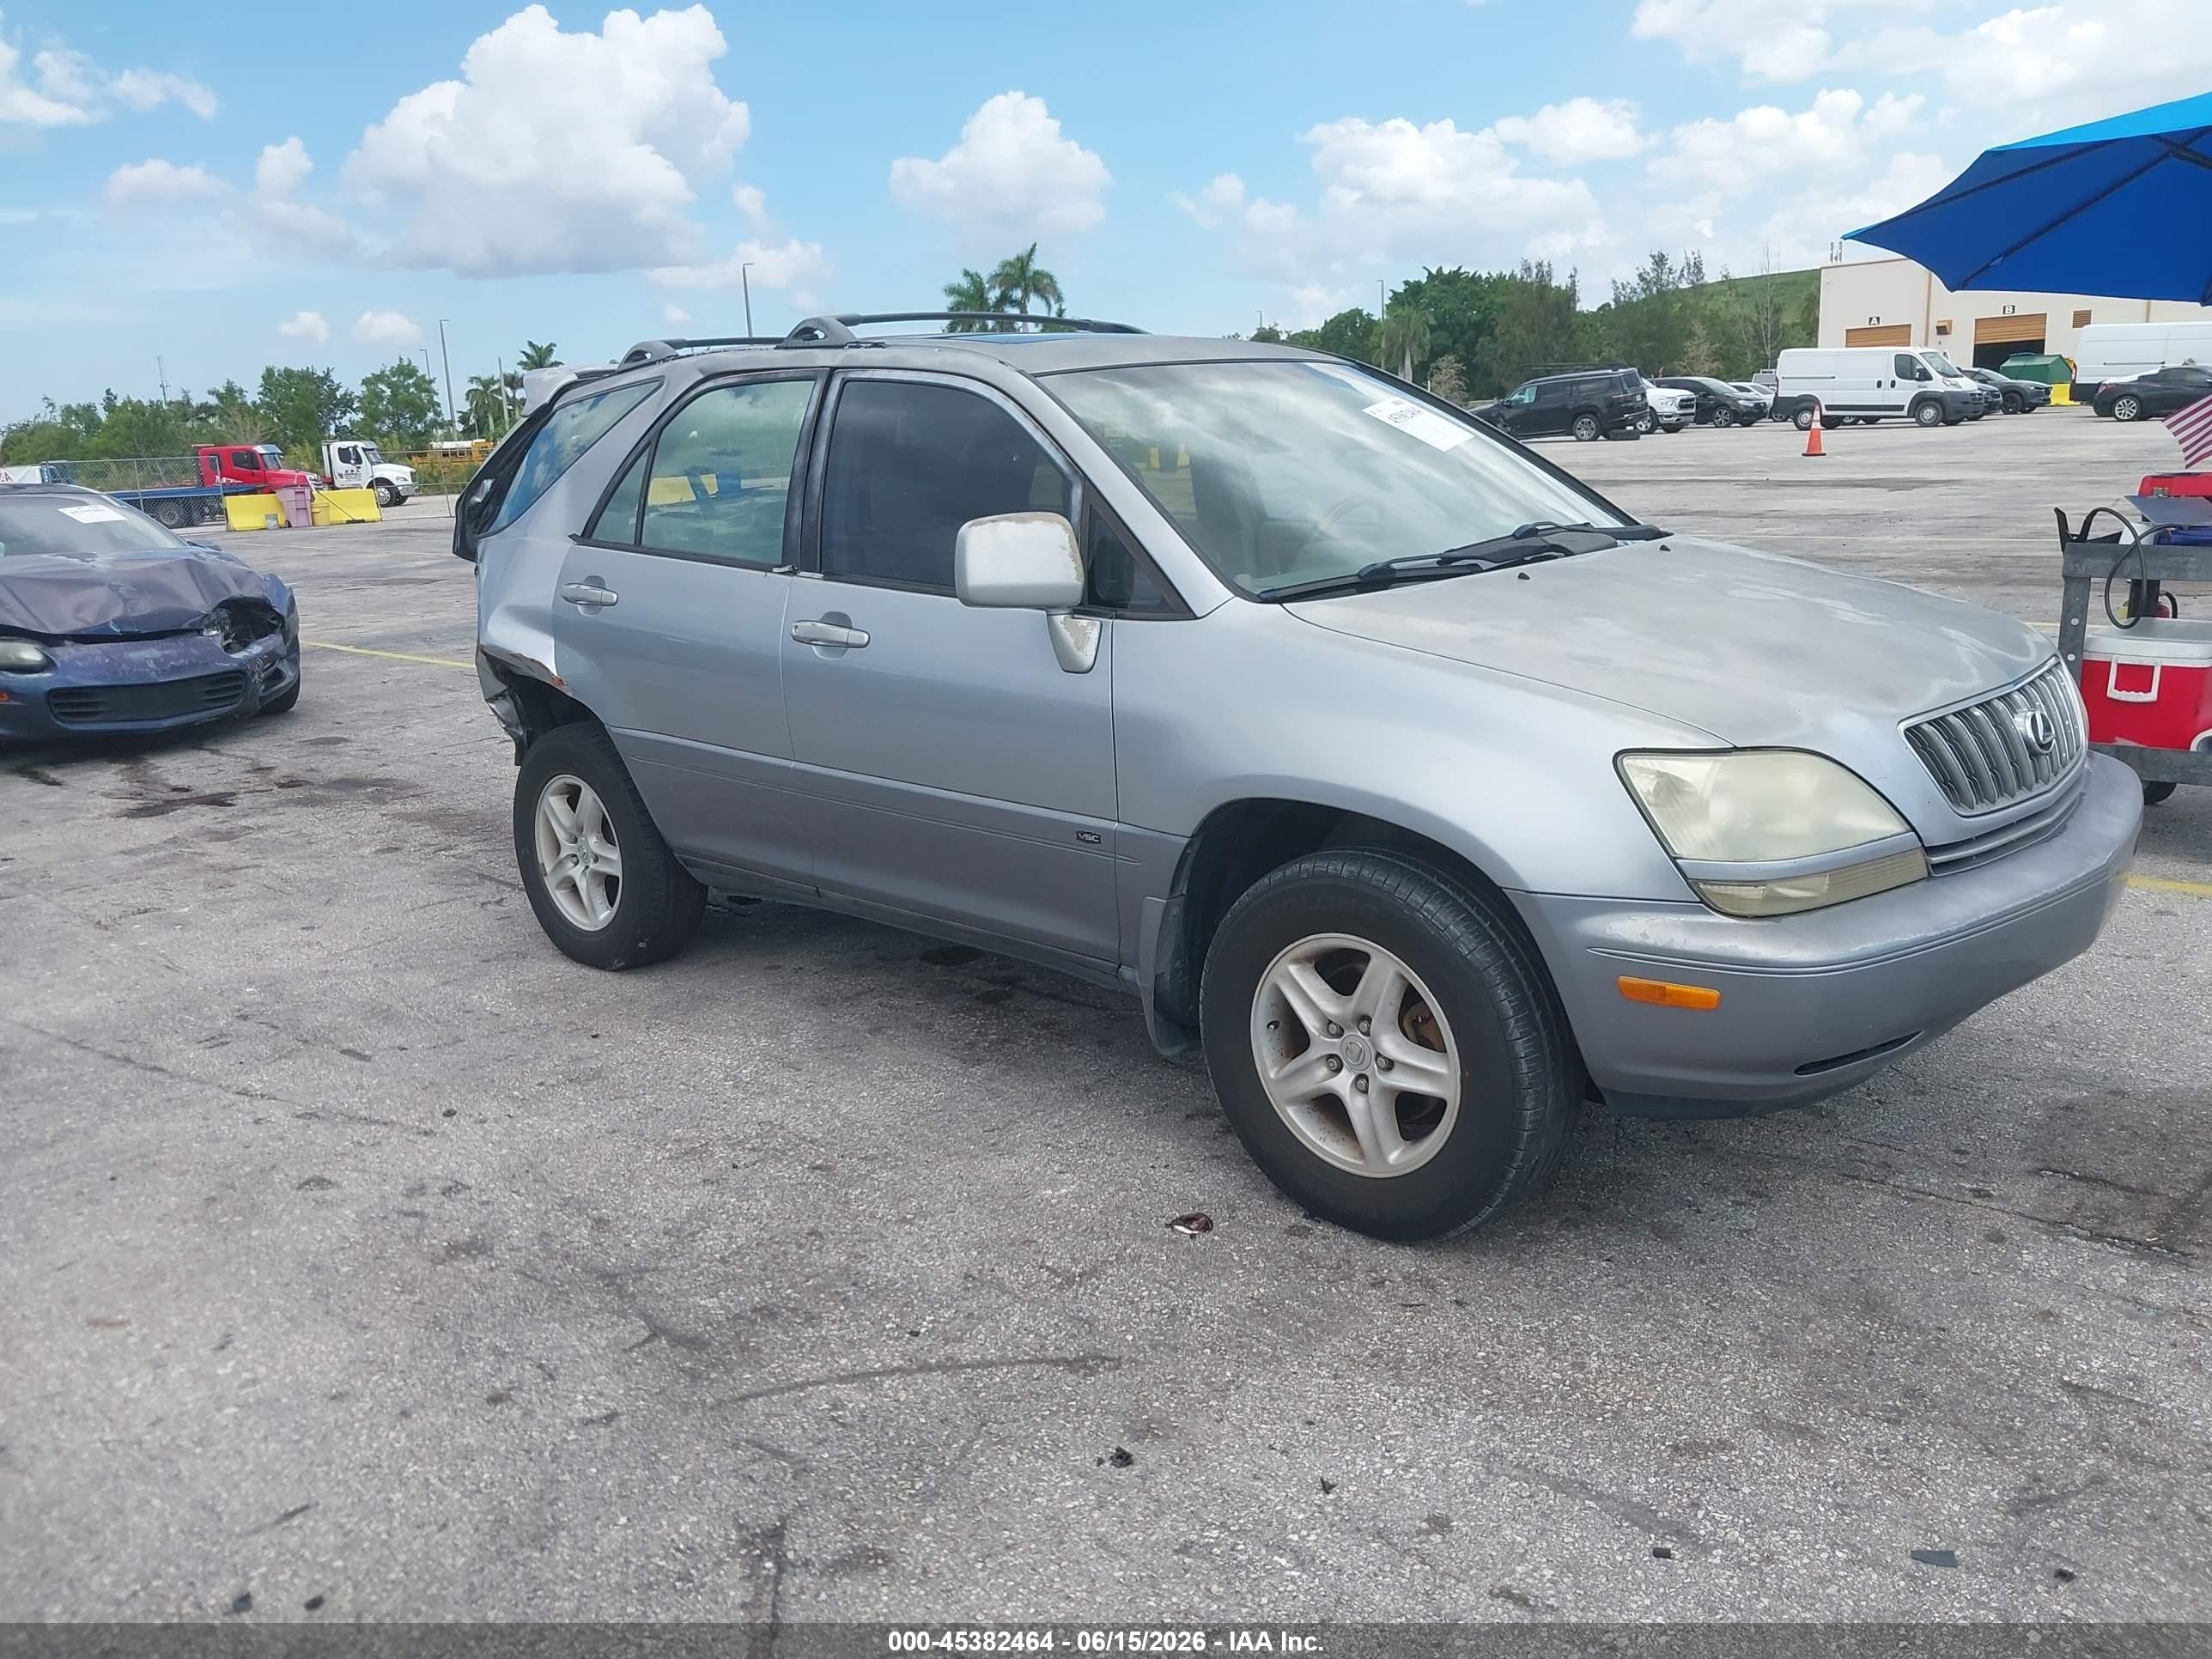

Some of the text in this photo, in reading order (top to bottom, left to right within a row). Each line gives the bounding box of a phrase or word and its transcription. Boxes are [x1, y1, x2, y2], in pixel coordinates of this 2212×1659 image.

[2004, 305, 2014, 314] B
[1869, 317, 1879, 325] A
[1078, 833, 1100, 842] VSC
